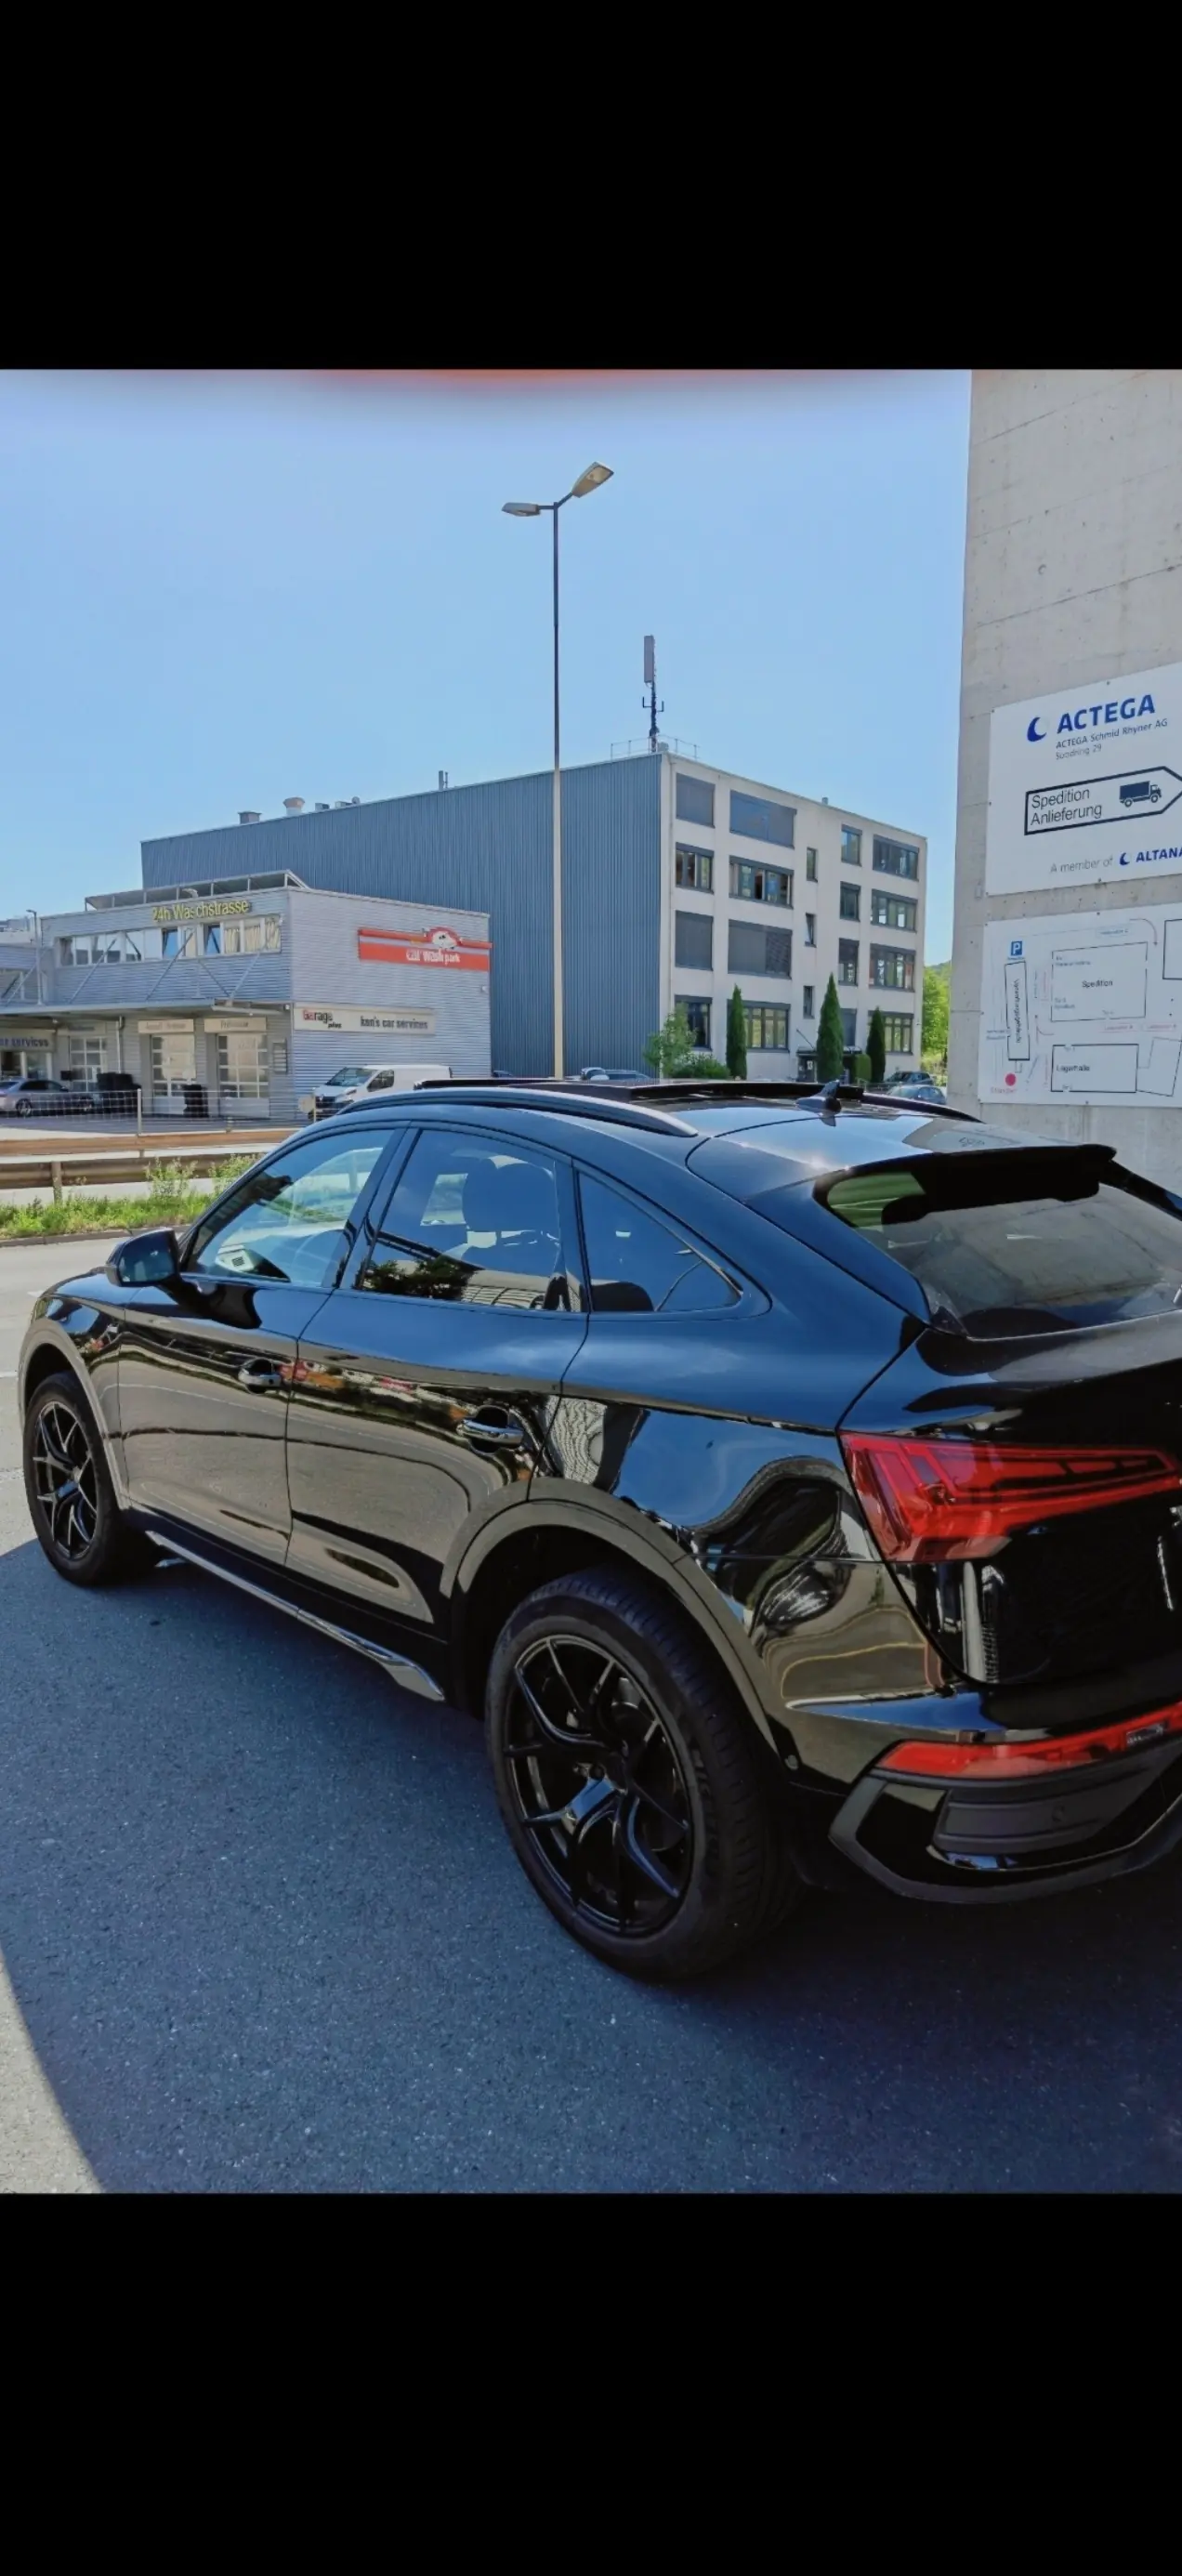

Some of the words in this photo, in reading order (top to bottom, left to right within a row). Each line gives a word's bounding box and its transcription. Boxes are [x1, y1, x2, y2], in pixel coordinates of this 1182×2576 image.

[1057, 694, 1156, 734] ACTEGA
[1056, 735, 1088, 749] ACTEGA
[1090, 729, 1120, 743] Schmid
[1123, 723, 1152, 736] Rhyner
[1154, 718, 1168, 729] AG
[1093, 744, 1102, 754] 29
[1031, 787, 1090, 810] Spedition
[1031, 804, 1102, 826] Anlieferung
[1050, 863, 1057, 874] A
[1060, 859, 1099, 873] member
[1103, 856, 1113, 867] of
[151, 906, 171, 922] 24h
[173, 900, 249, 920] Waschstrasse
[1082, 979, 1113, 989] Spedition
[303, 1009, 334, 1024] Garage
